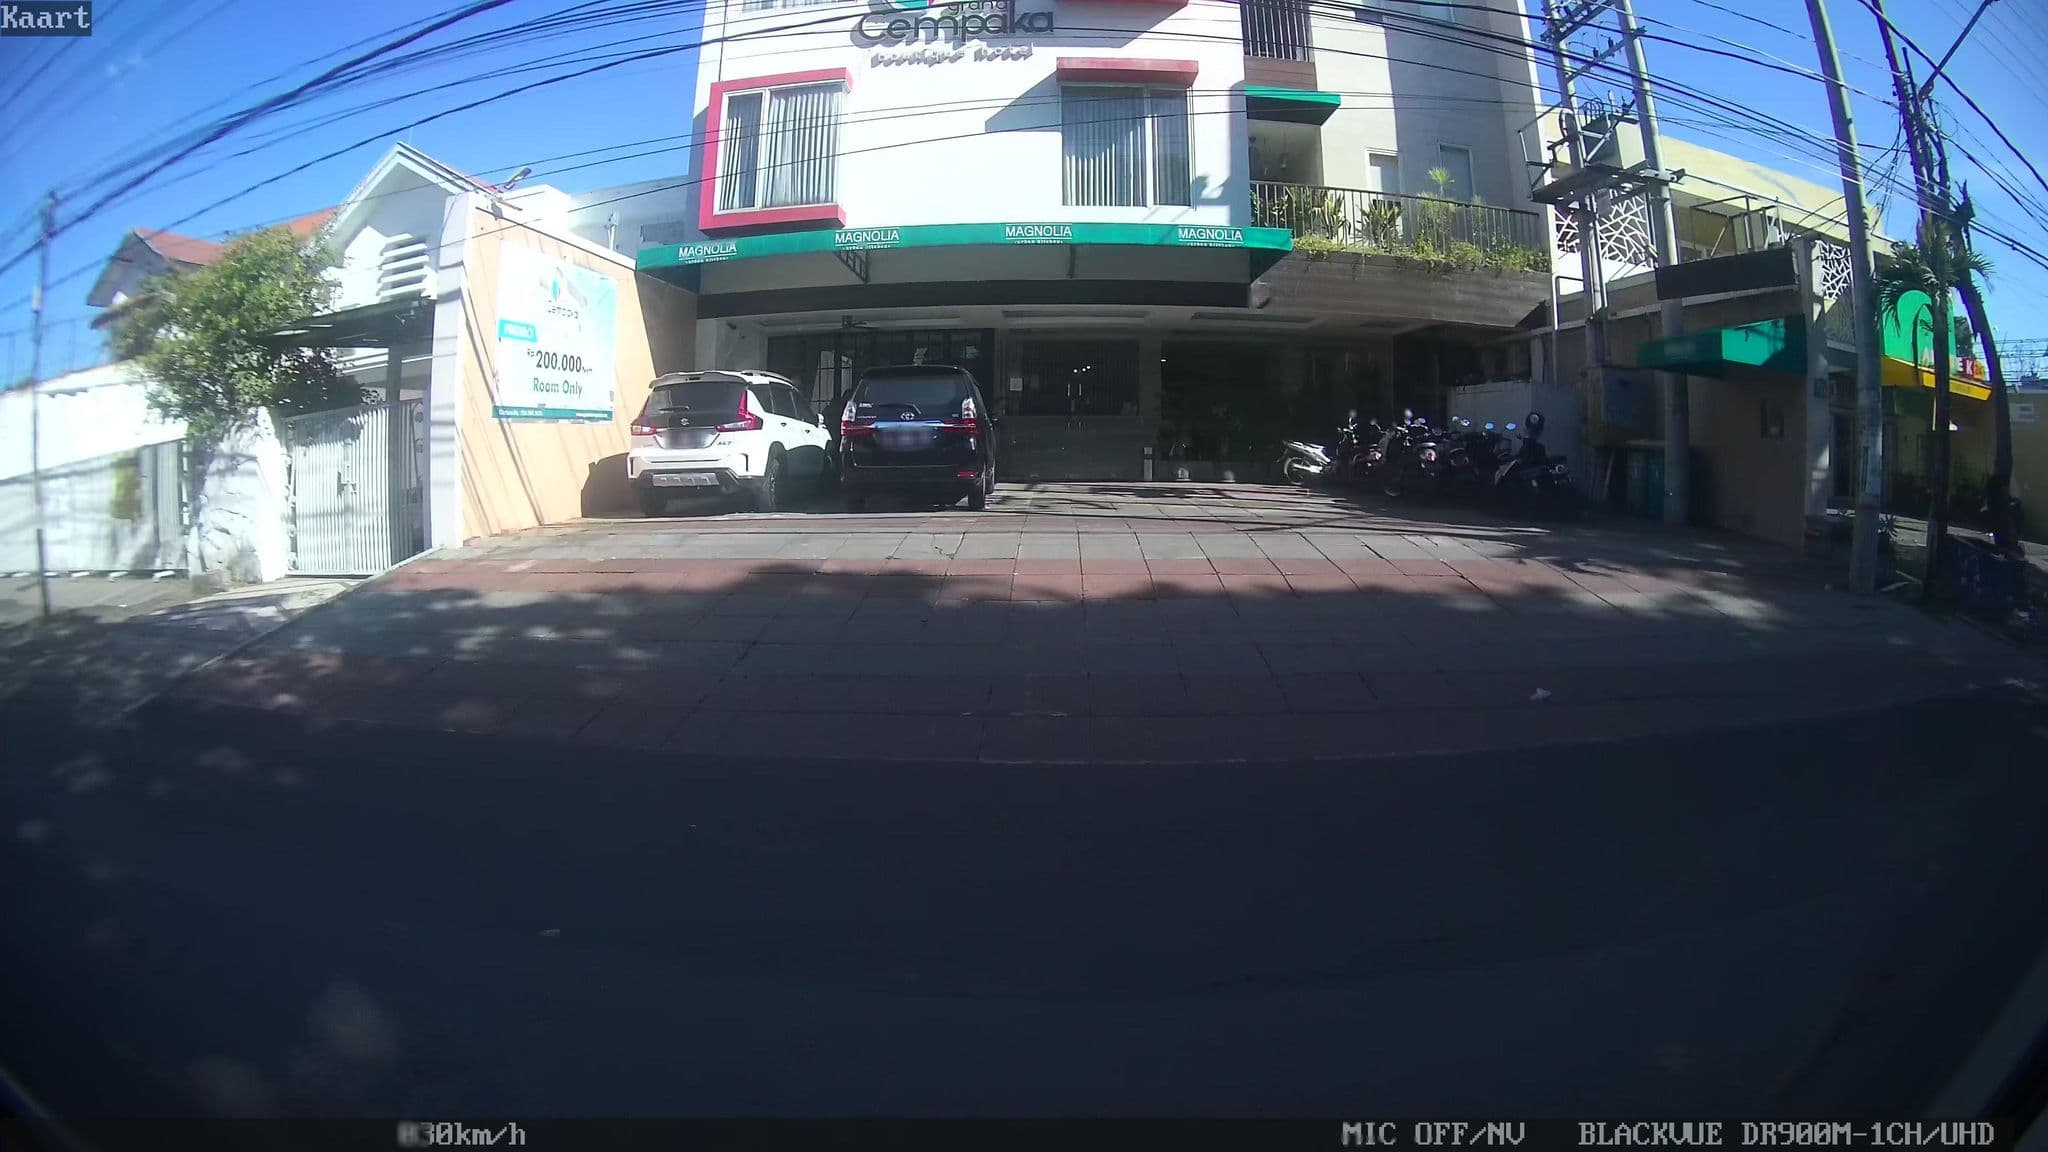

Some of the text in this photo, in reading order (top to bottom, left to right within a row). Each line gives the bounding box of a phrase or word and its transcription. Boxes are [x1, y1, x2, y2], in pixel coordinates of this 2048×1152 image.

[858, 0, 1055, 44] Cempaka
[834, 230, 900, 243] MAGNOLIA
[1005, 225, 1072, 237] MAGNOLIA
[1178, 227, 1243, 241] MAGNOLIA
[678, 242, 737, 258] MAGNOLIA
[536, 350, 582, 373] 200.000
[533, 378, 583, 398] Room Only
